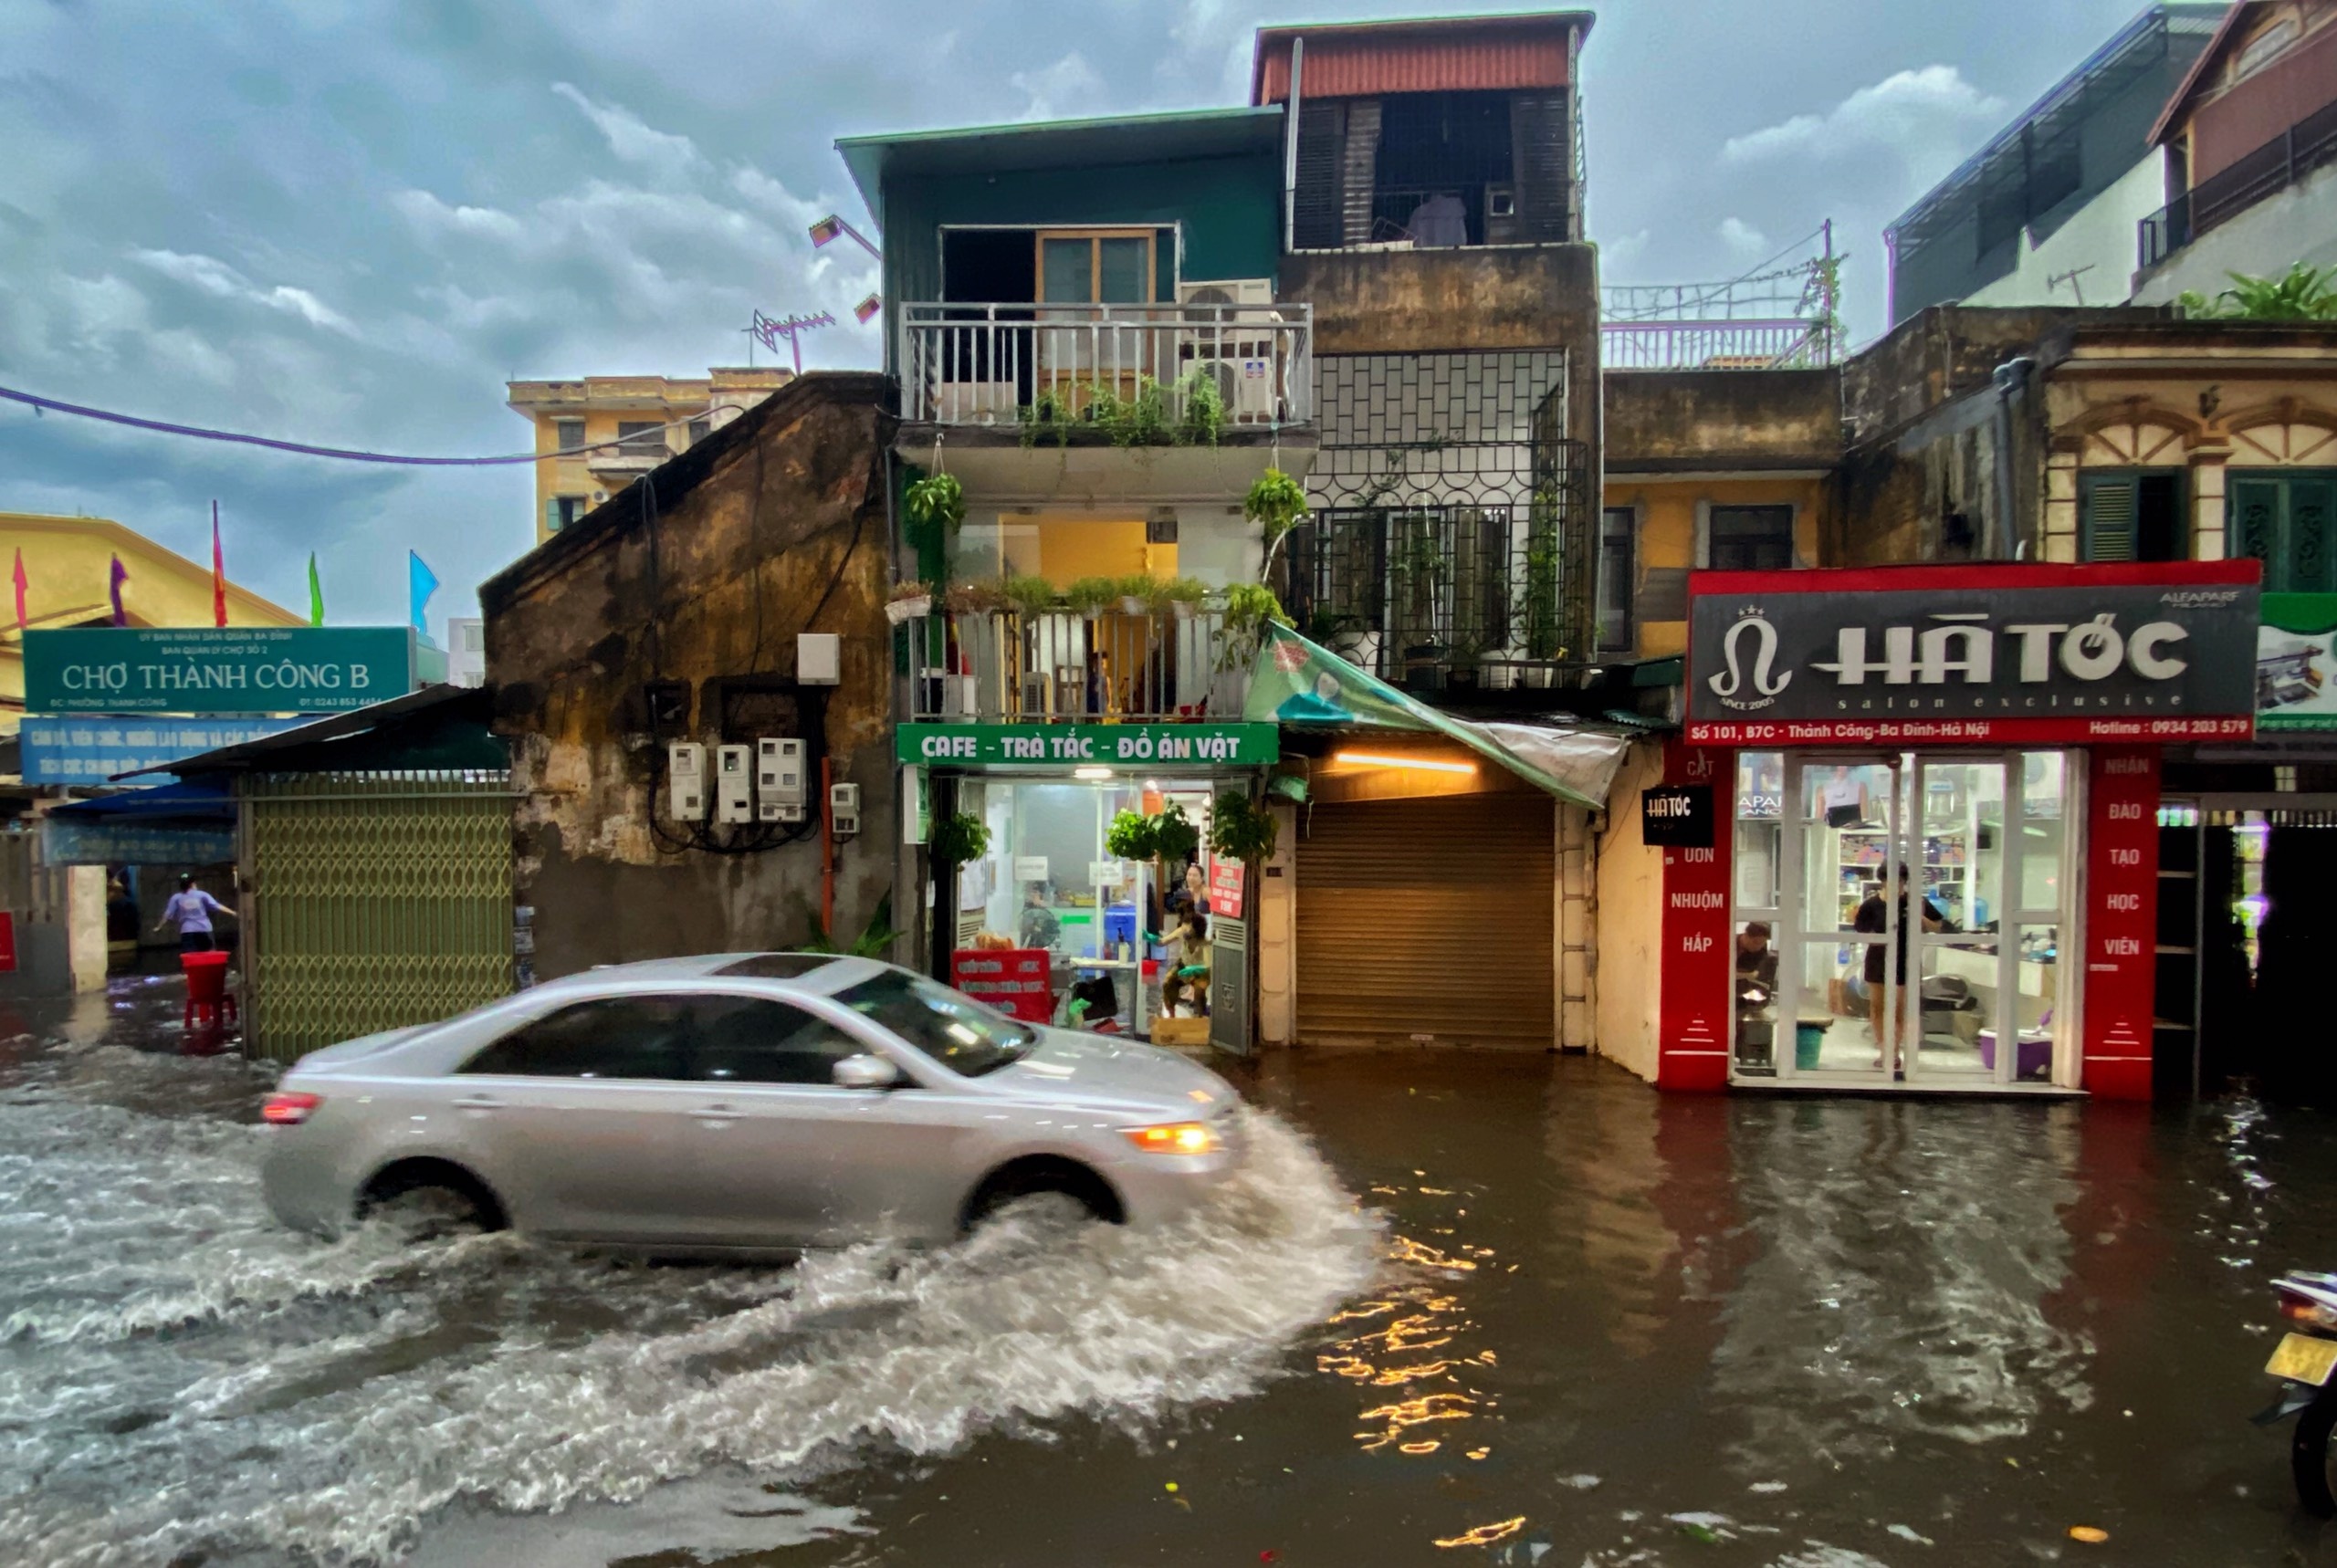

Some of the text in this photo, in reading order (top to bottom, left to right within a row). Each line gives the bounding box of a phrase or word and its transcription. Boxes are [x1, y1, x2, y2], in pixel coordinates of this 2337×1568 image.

[2160, 591, 2239, 602] ALFAPARF
[162, 646, 181, 655] BAN
[262, 646, 267, 654] 2
[62, 656, 370, 694] CHỢ THÀNH CÔNG B
[1719, 696, 1775, 710] SINCE 2005
[1838, 694, 2184, 709] salon exclusive
[1692, 724, 1710, 739] Số
[1745, 725, 1775, 739] B7C
[1788, 723, 1831, 738] Thành
[1965, 722, 1990, 738] Nội
[2090, 721, 2141, 735] Hotline
[2152, 720, 2188, 734] 0934
[2221, 720, 2248, 733] 579
[921, 736, 977, 758] CAFE
[1001, 732, 1045, 758] TRÀ
[1051, 727, 1095, 758] TẮC
[1116, 727, 1154, 758] ĐỒ
[1158, 732, 1190, 758] ĂN
[1195, 732, 1241, 763] VẶT
[2109, 849, 2140, 867] TẠO
[1672, 890, 1724, 911] NHUỘM
[2107, 894, 2140, 913] HỌC
[2104, 936, 2140, 955] VIÊN
